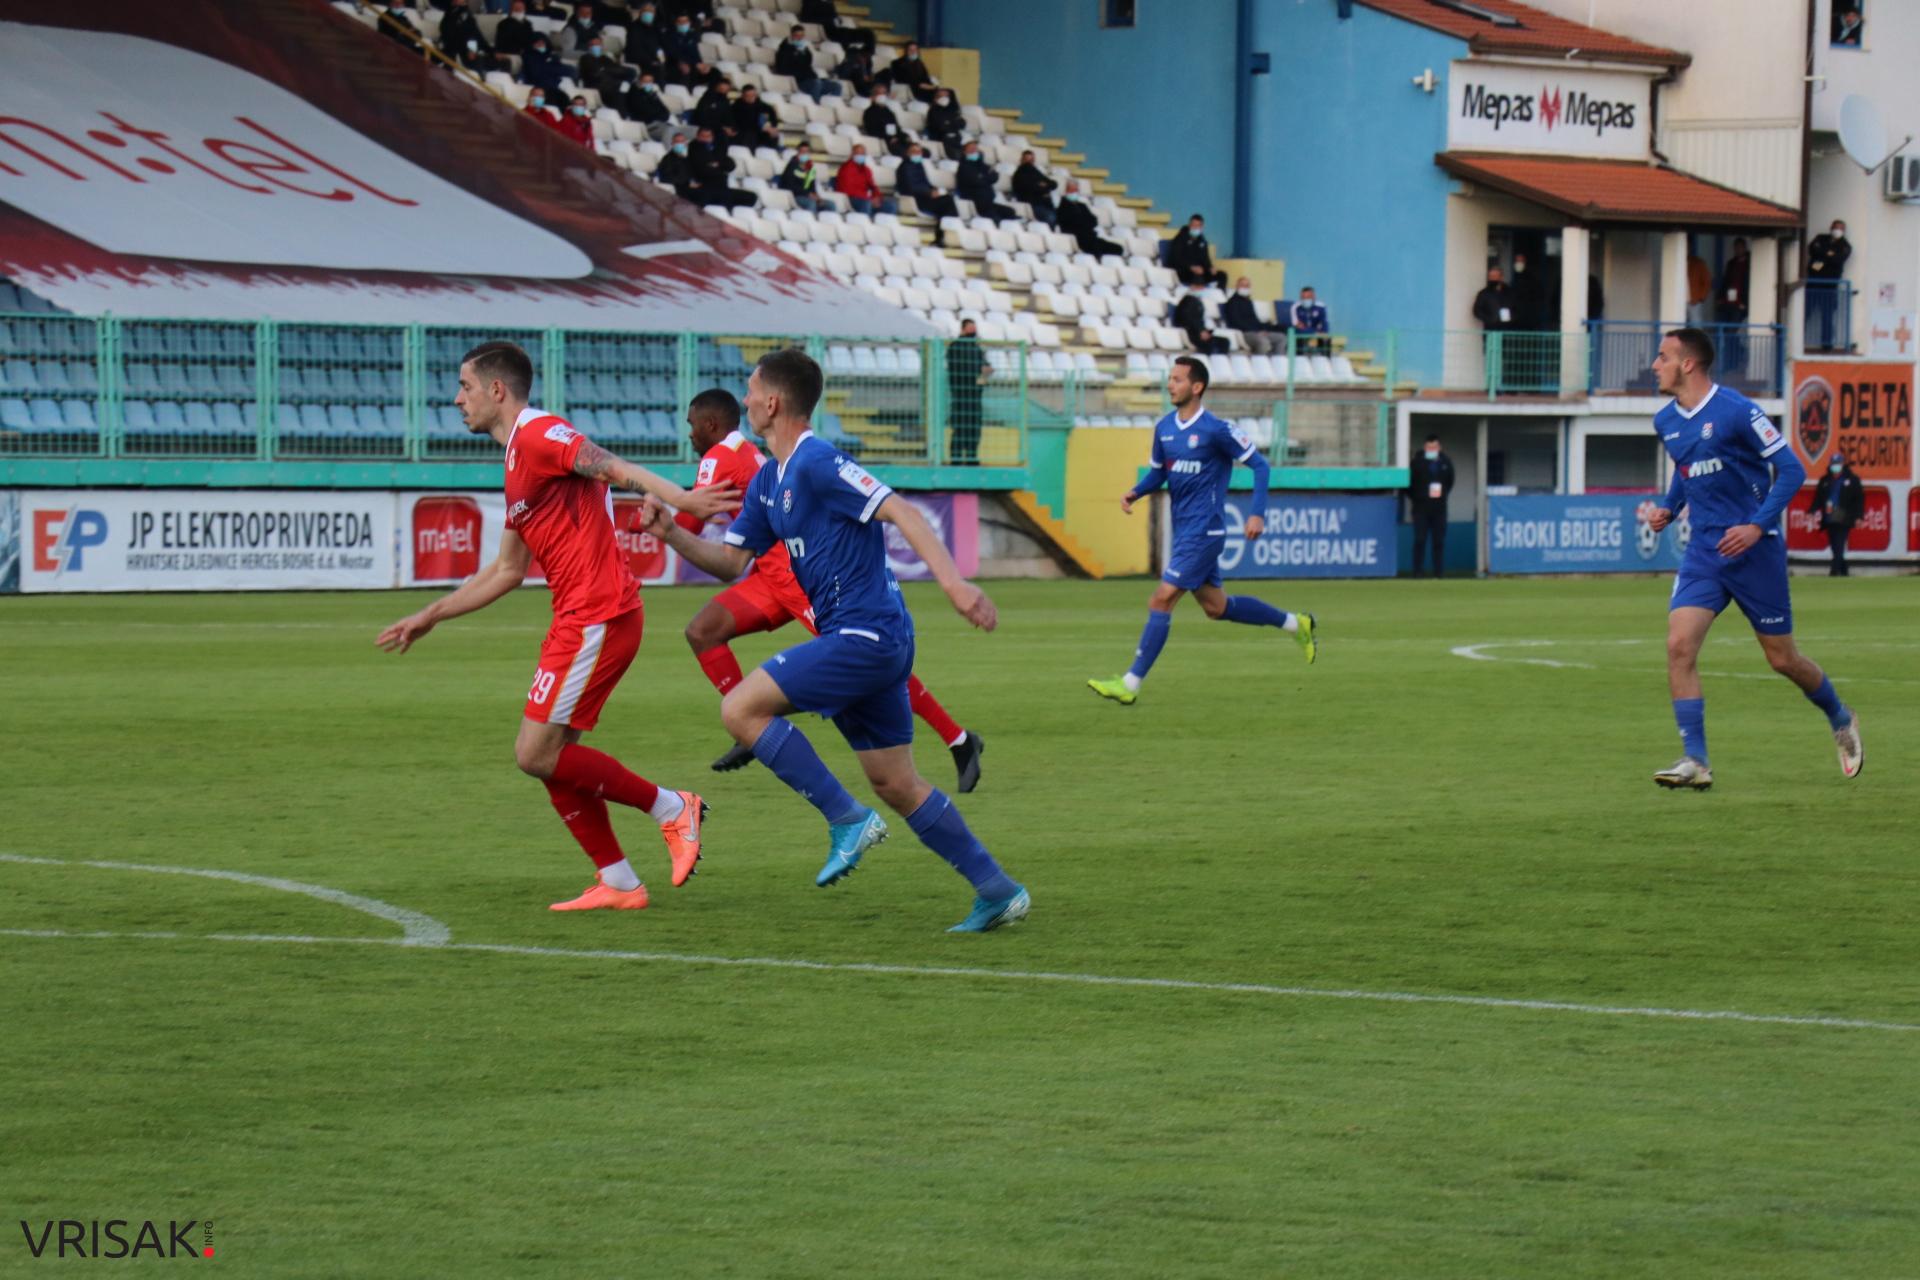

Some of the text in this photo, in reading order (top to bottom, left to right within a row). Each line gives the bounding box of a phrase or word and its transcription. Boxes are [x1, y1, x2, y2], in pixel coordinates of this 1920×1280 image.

[1462, 84, 1637, 137] Mepas Mepas
[1840, 383, 1911, 429] DELTA
[1839, 436, 1910, 467] SECURITY
[128, 511, 154, 548] JP
[162, 511, 373, 548] ELEKTROPRIVREDA
[418, 520, 475, 553] m:tel
[1263, 508, 1341, 535] ROATIA
[1494, 516, 1621, 548] ŠIROKI BRIJEG
[1253, 538, 1378, 565] OSIGURANJE
[528, 667, 555, 705] 29
